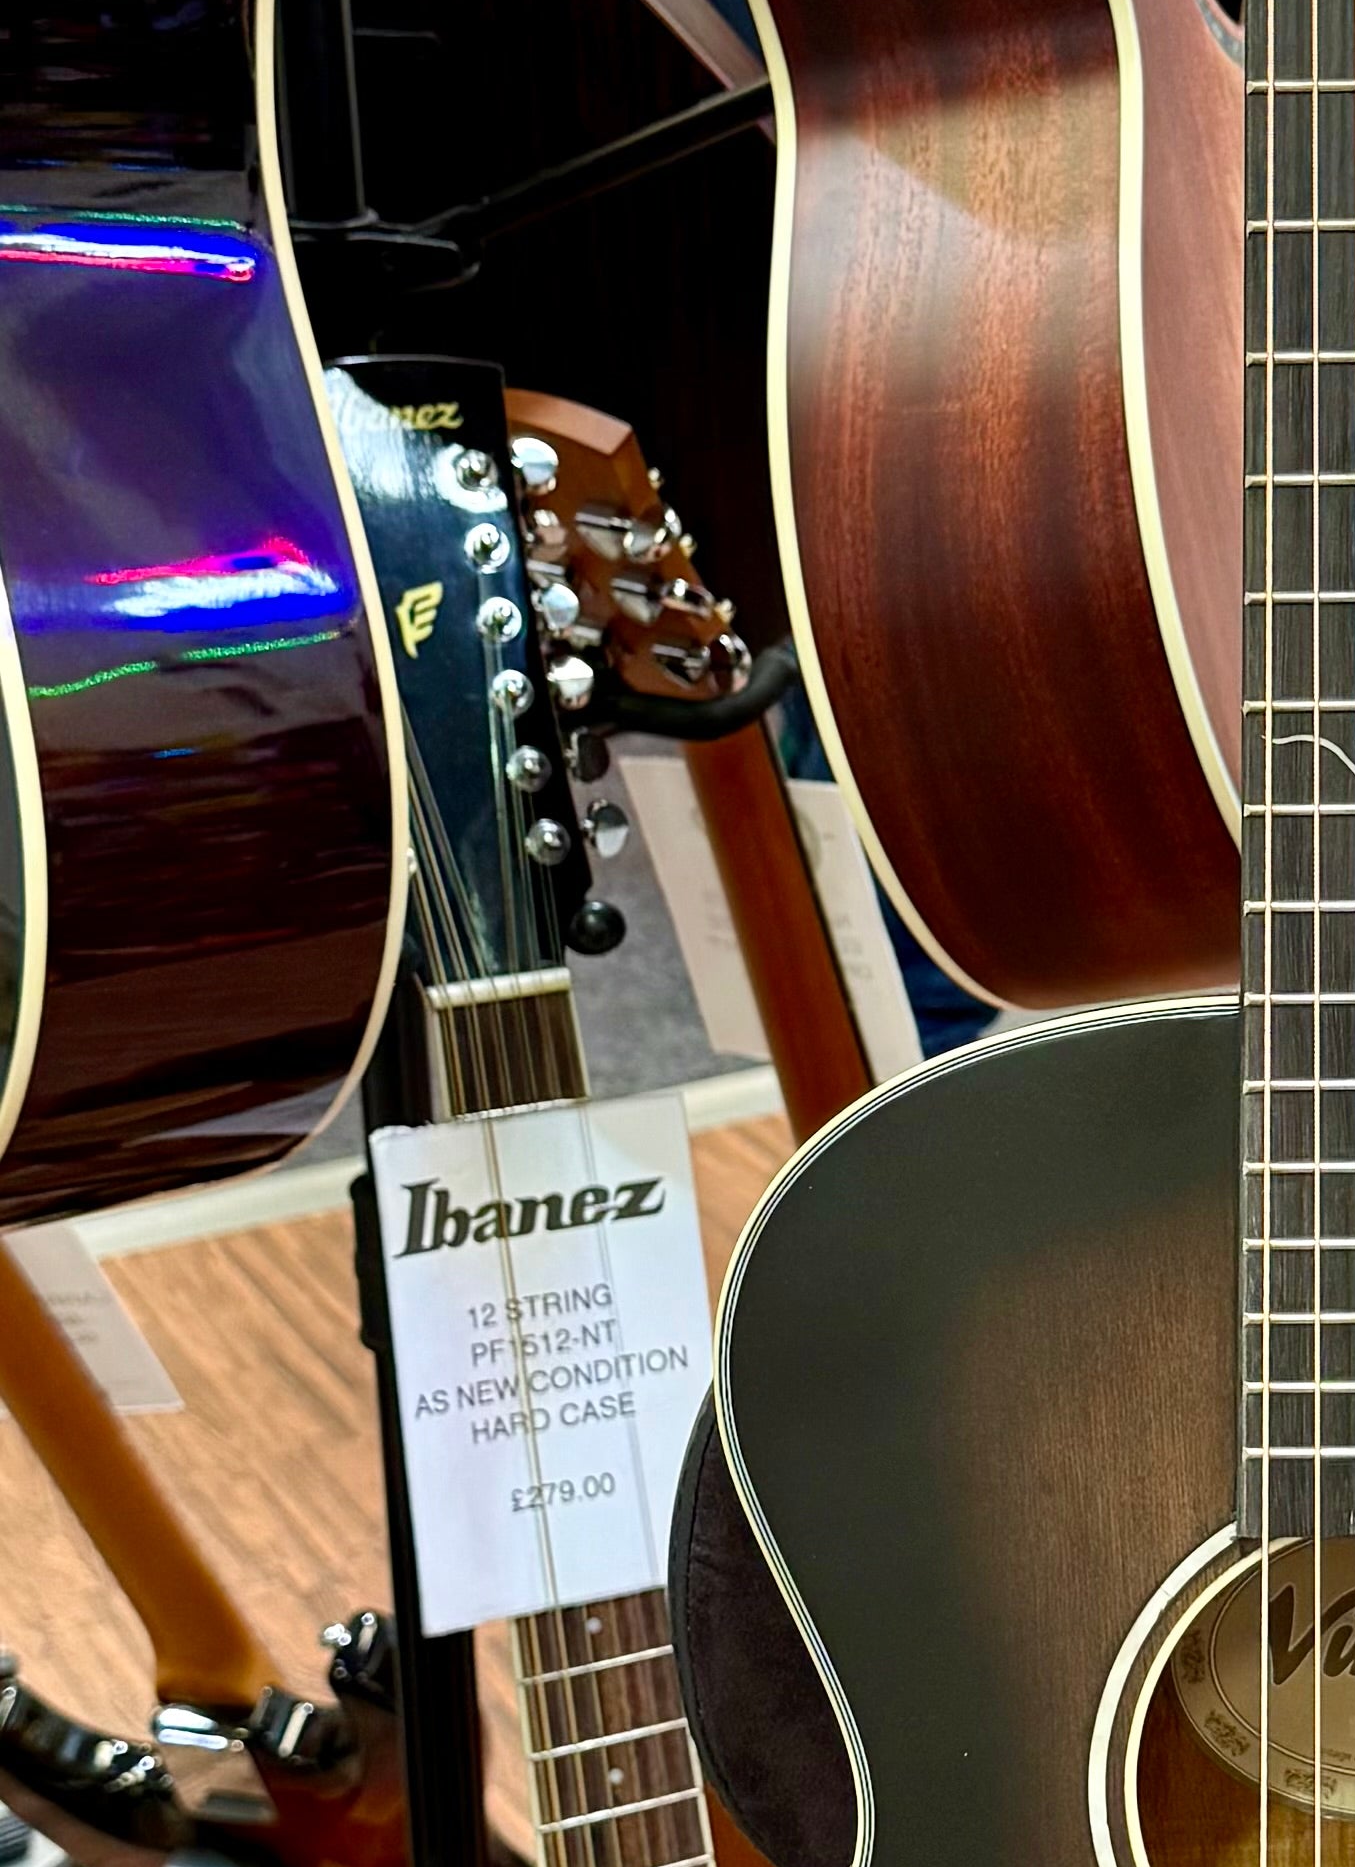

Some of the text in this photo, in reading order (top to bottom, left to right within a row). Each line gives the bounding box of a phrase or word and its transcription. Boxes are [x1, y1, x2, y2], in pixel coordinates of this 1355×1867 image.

[393, 1177, 666, 1259] Ibanez
[468, 1284, 613, 1330] 12 STRING
[414, 1345, 689, 1419] AS NEW CONDITION
[471, 1392, 637, 1445] HARD CASE
[511, 1472, 617, 1513] £279.00
